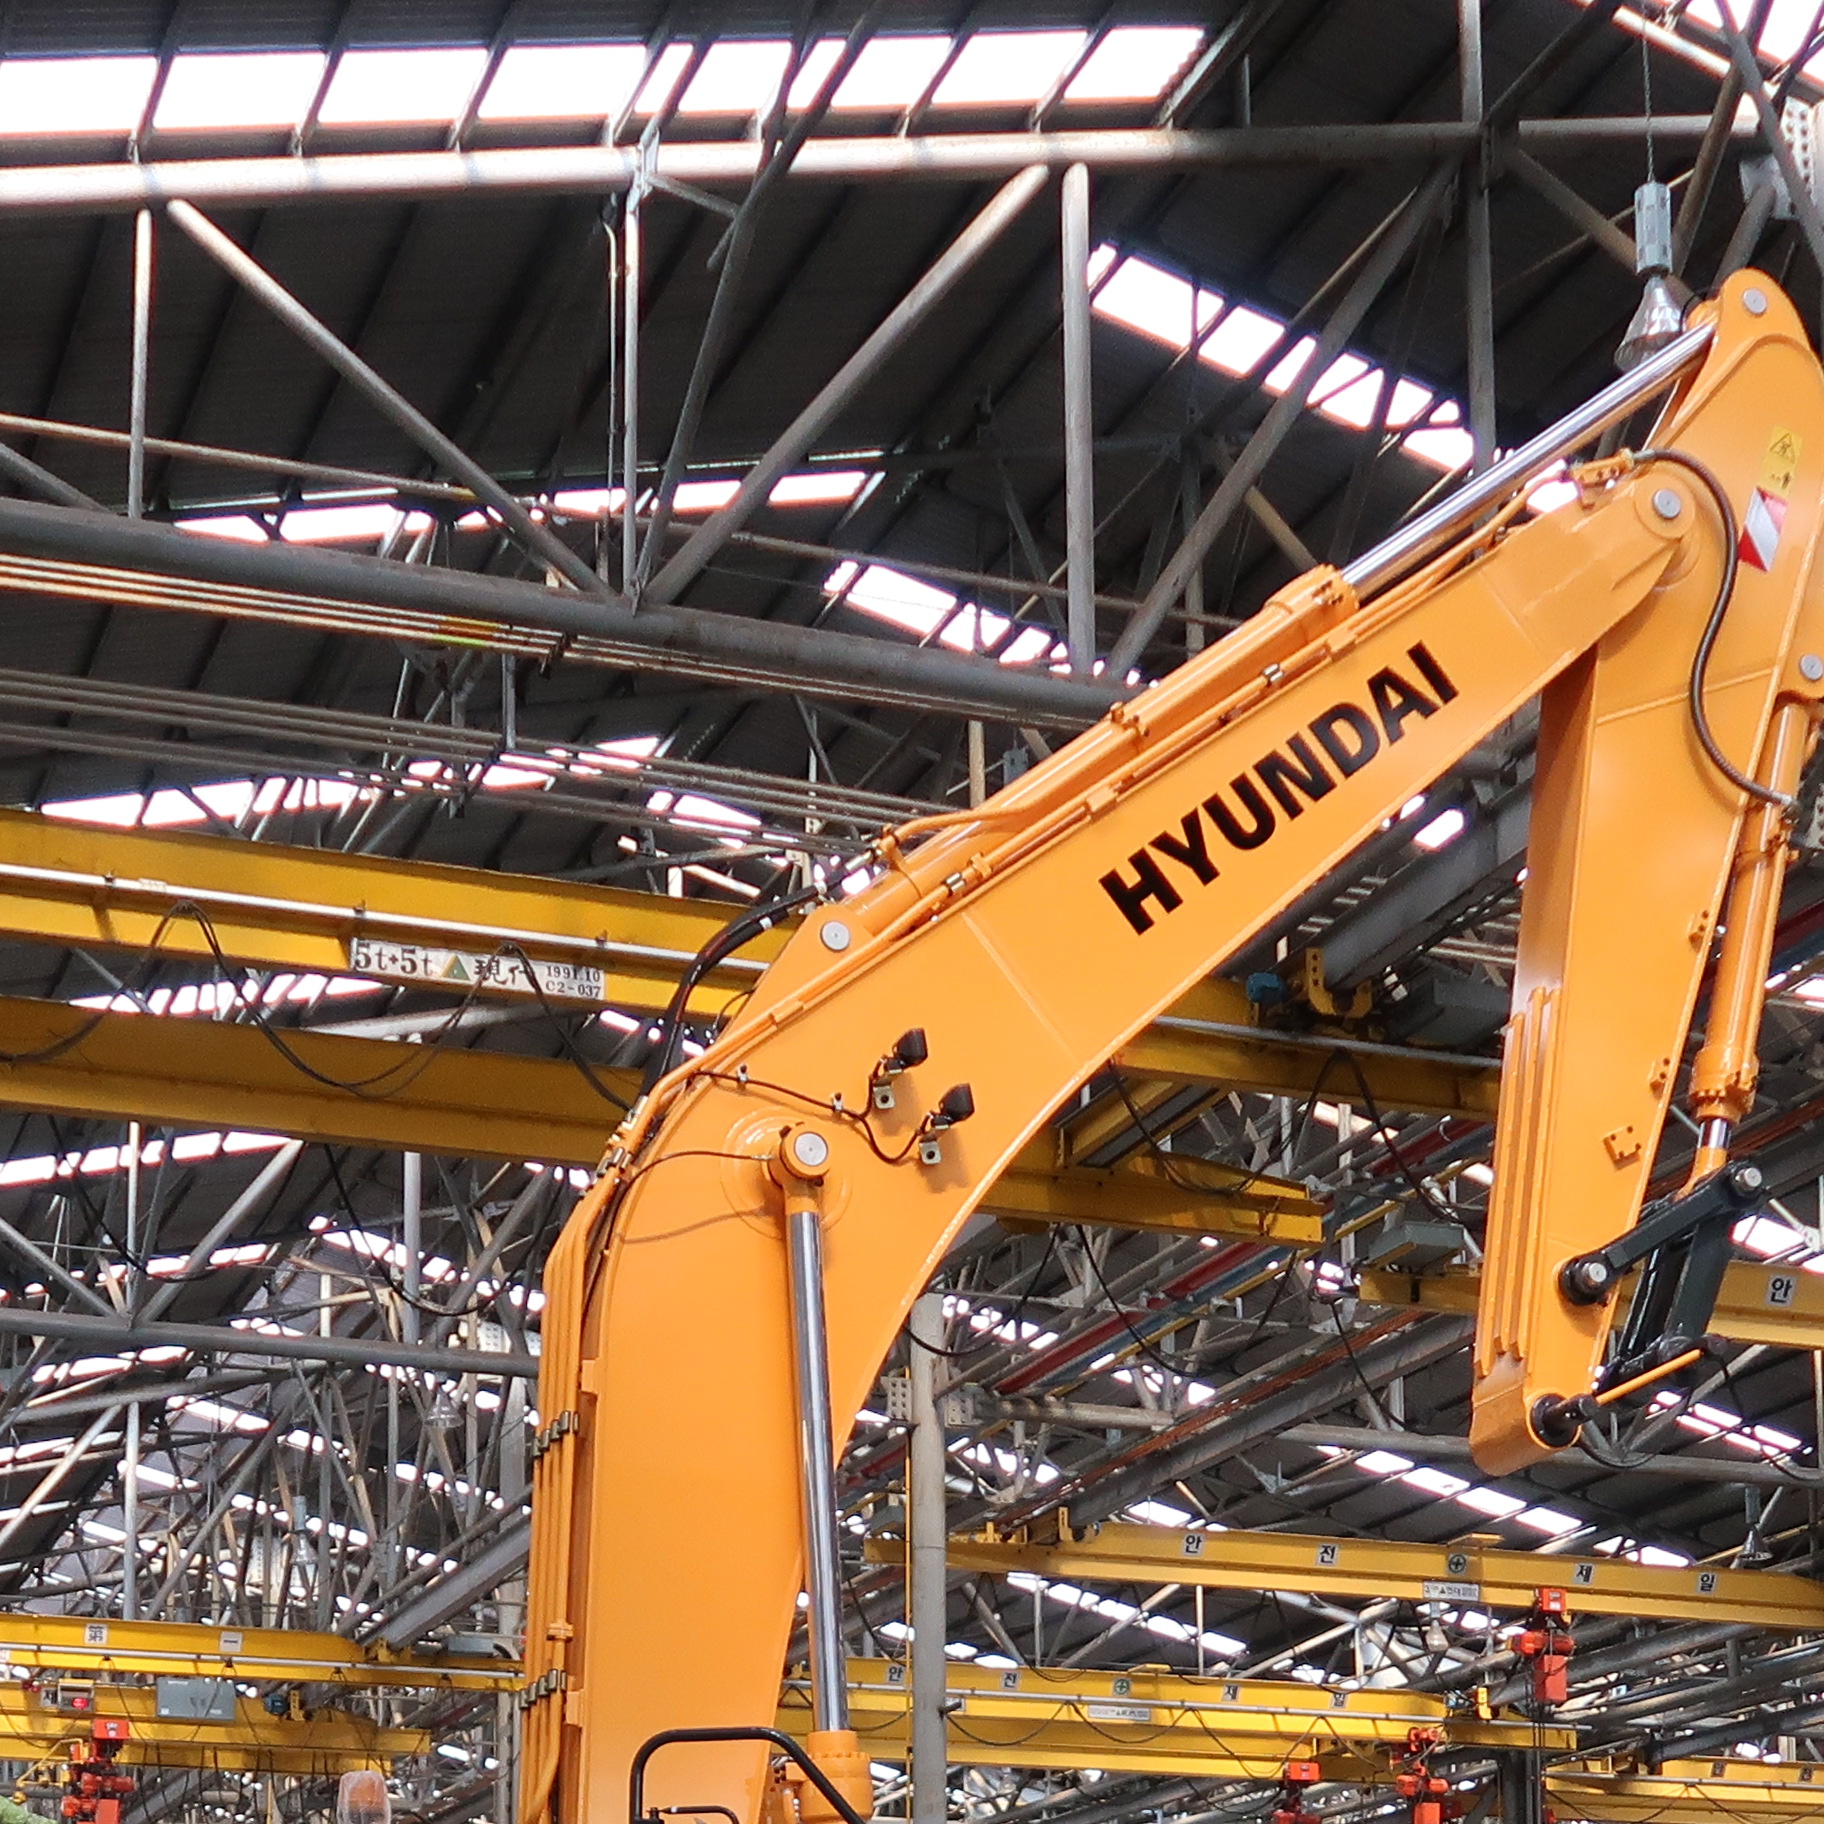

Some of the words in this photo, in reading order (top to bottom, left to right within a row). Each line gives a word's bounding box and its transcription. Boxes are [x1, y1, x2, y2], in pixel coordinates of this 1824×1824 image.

[1099, 640, 1459, 935] HYUNDAI
[546, 965, 601, 983] 1991.10
[545, 980, 601, 999] C2-037
[1771, 1277, 1794, 1304] 안
[1185, 1535, 1202, 1554] 안
[1319, 1546, 1336, 1564] 전
[1576, 1565, 1592, 1583] 제
[1699, 1573, 1715, 1592] 일
[889, 1665, 905, 1682] 안
[1004, 1672, 1017, 1688] 전
